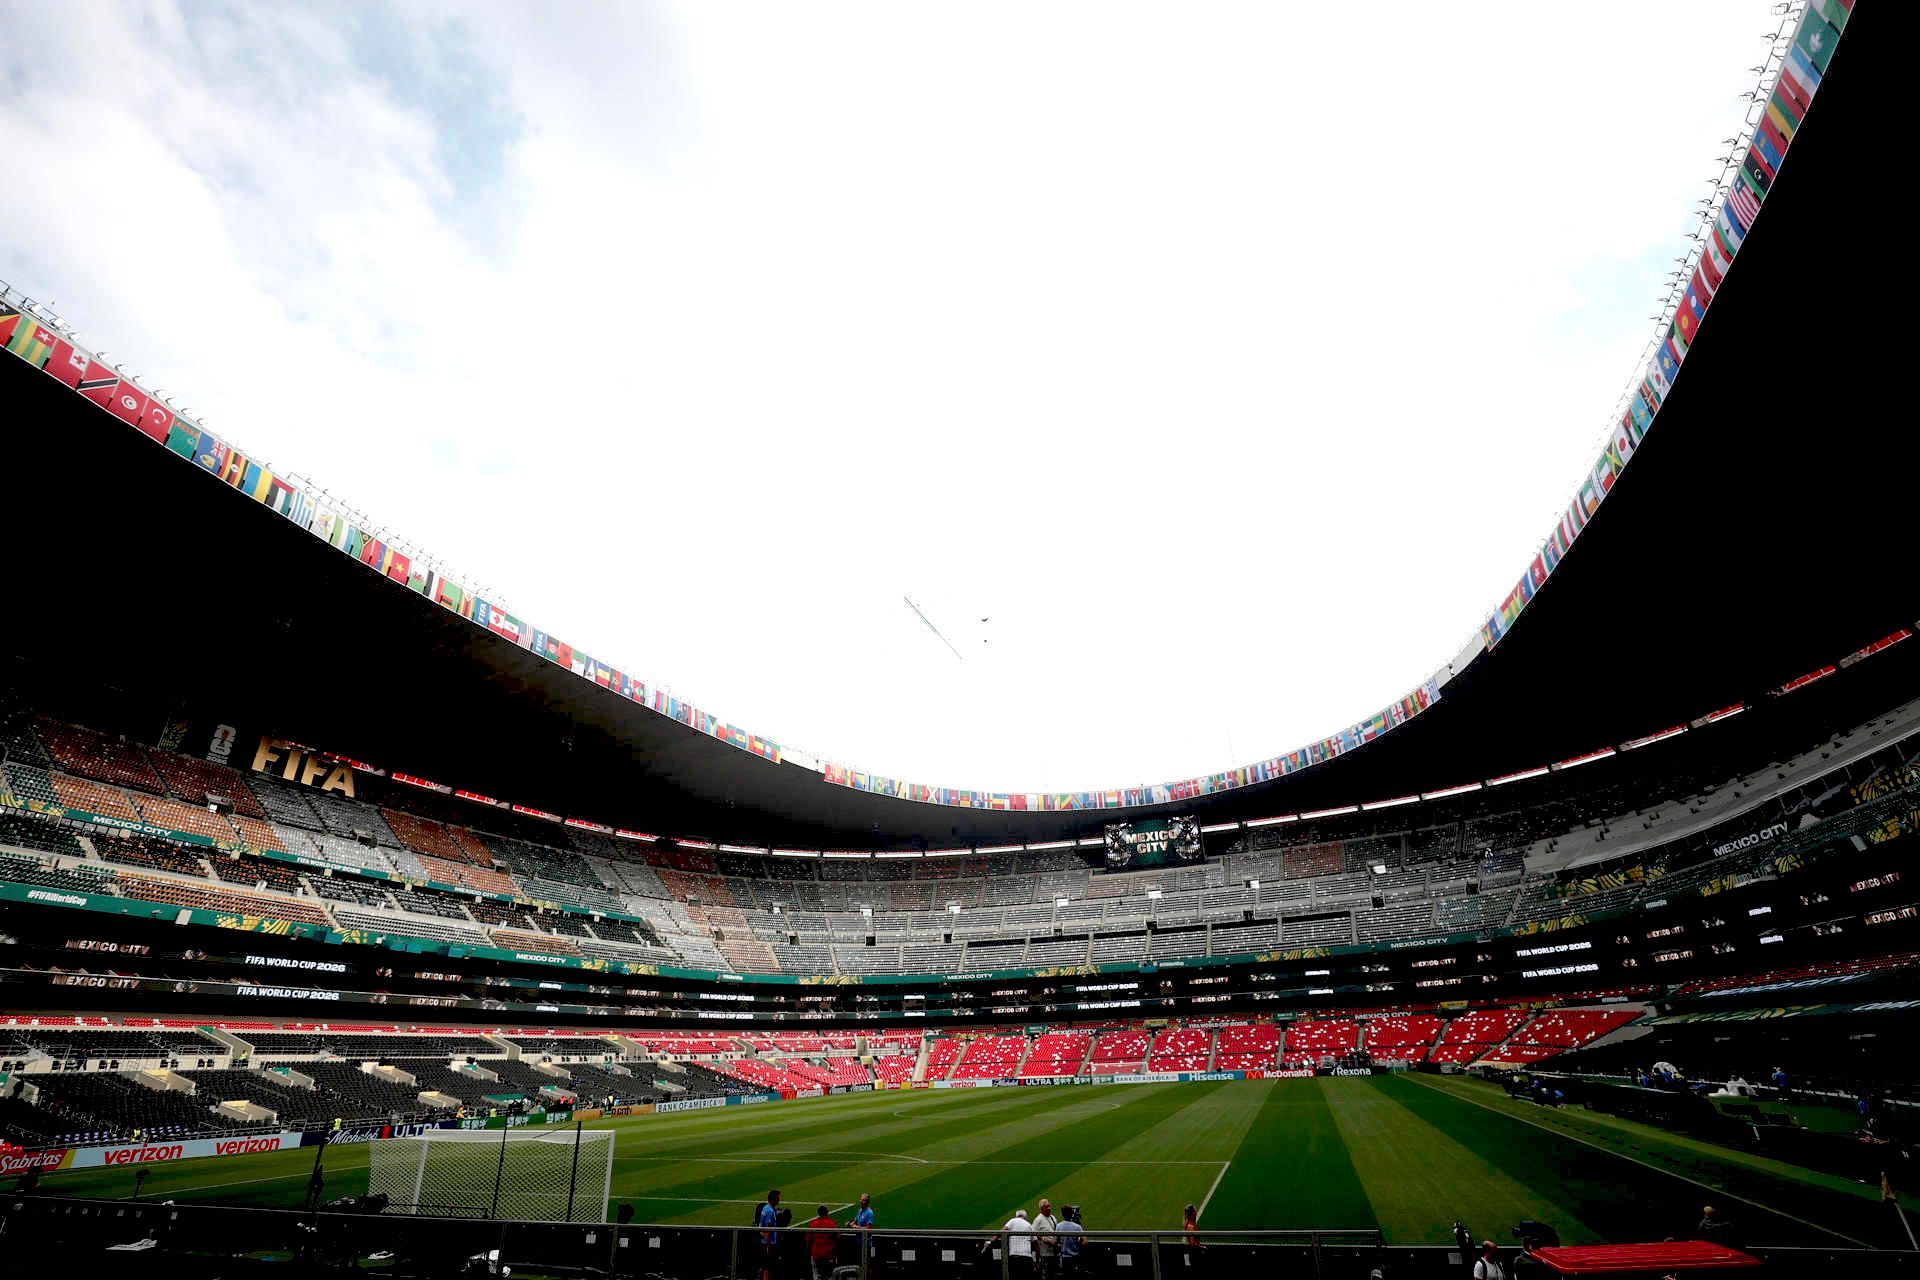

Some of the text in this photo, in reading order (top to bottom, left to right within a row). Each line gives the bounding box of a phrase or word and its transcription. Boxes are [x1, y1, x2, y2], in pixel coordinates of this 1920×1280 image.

[251, 736, 355, 798] FIFA
[93, 815, 171, 837] MEXICO CITY
[1125, 829, 1178, 844] MEXICO
[1713, 821, 1788, 857] MEXICO CITY
[1137, 841, 1168, 854] CITY
[1850, 872, 1900, 892] MEXICO CITY
[1864, 907, 1917, 925] MEXICO CITY
[1647, 925, 1684, 938] MEXICO CITY
[65, 939, 150, 955] MEXICO CITY
[1391, 940, 1425, 948] MEXICO
[1531, 946, 1555, 955] WORLD
[1555, 944, 1568, 952] CUP
[1568, 942, 1592, 950] 2026
[516, 953, 566, 964] MEXICO CITY
[1412, 957, 1456, 968] MEXICO CITY
[1655, 950, 1693, 962] MEXICO CITY
[245, 955, 346, 972] FIFA WORLD CUP 2026
[1537, 968, 1561, 976] WORLD
[1562, 966, 1575, 974] CUP
[1575, 963, 1599, 972] 2026
[52, 975, 139, 988] MEXICO CITY
[414, 971, 463, 982] MEXICO CITY
[237, 986, 340, 1000] FIFA WORLD CUP 2026
[1355, 1012, 1389, 1020] MEXICO
[1189, 1072, 1234, 1081] Hisense
[1263, 1069, 1313, 1078] McDonald's
[1337, 1067, 1371, 1076] Rexona
[950, 1080, 976, 1088] verizon
[658, 1099, 717, 1112] BANK OF AMERICA
[394, 1123, 440, 1137] ULTRA
[215, 1136, 280, 1155] verizon
[103, 1143, 183, 1165] verizon
[0, 1152, 62, 1174] Sabritas
